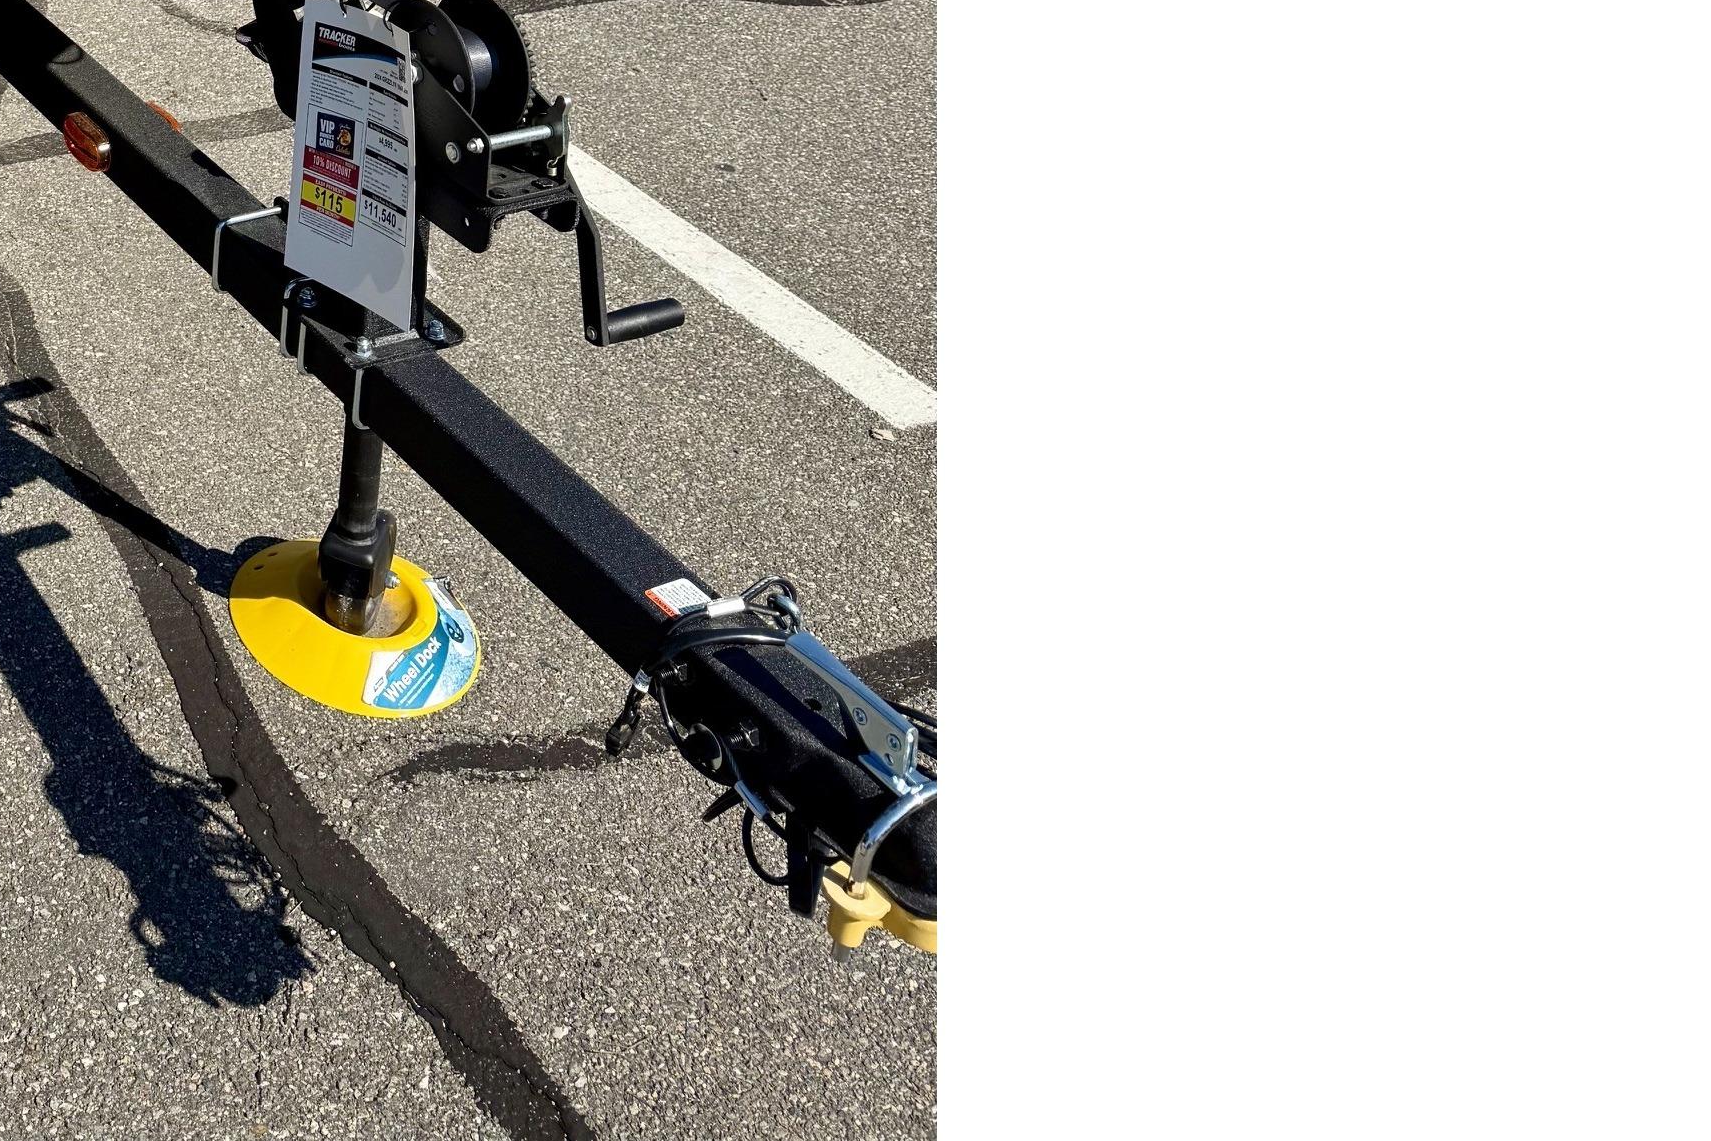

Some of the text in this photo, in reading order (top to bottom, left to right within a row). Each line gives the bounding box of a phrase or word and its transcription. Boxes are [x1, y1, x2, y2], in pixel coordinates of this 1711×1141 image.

[318, 26, 357, 47] TRACKER
[320, 119, 335, 134] VIP
[319, 138, 334, 149] CARD
[313, 155, 325, 168] 10%
[325, 159, 352, 178] DISCOUNT
[314, 186, 344, 214] $115
[364, 199, 397, 228] $11,540
[383, 660, 421, 703] Wheel
[414, 636, 442, 669] Dock
